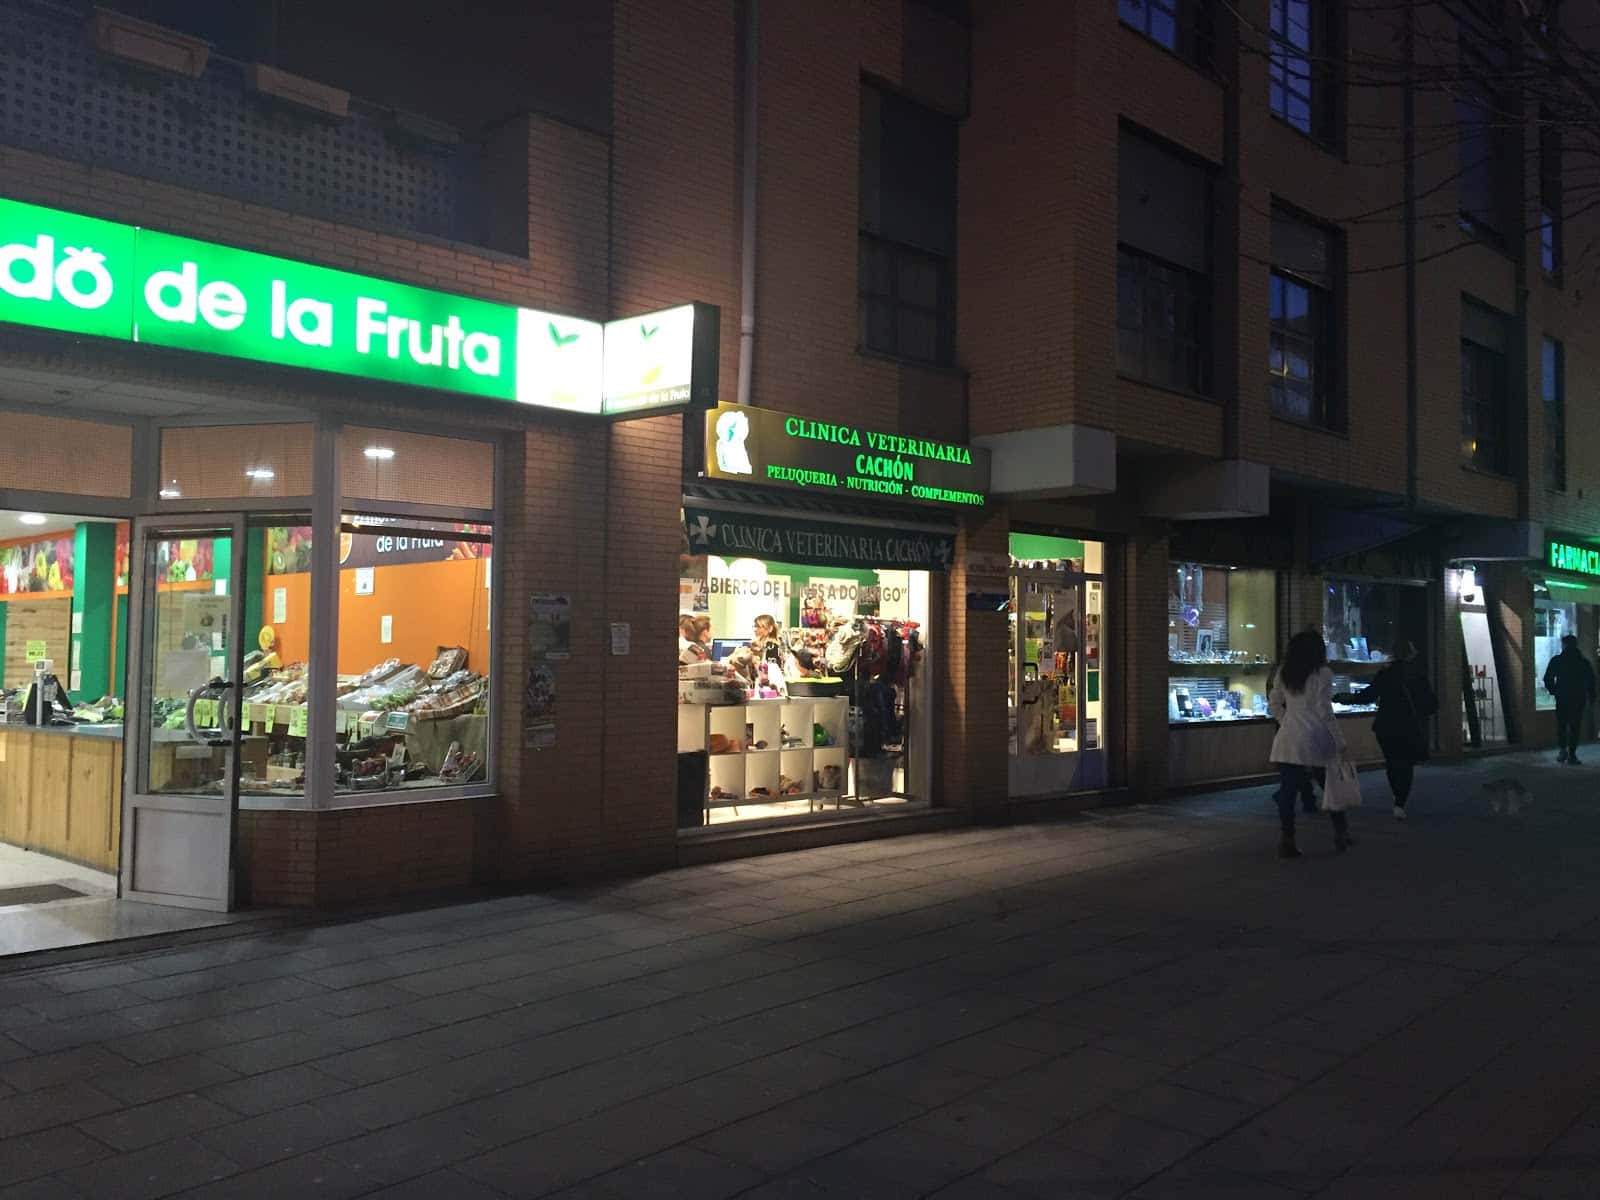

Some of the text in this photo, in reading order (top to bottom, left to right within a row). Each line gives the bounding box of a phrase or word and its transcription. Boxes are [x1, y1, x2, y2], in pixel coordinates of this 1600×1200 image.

[144, 261, 247, 331] de
[271, 279, 333, 347] la
[356, 296, 500, 377] Fruta
[785, 416, 972, 465] CLINICA VETERINARIA
[767, 464, 985, 506] PELUQUERIA NUTRICIÓN COMPLEMENTOS
[855, 453, 914, 481] CACHÓN
[376, 535, 393, 553] de
[721, 523, 783, 553] CLINICA
[785, 531, 884, 562] VETERINARIA
[763, 580, 780, 597] DE
[784, 580, 825, 599] LNES
[827, 584, 837, 600] A
